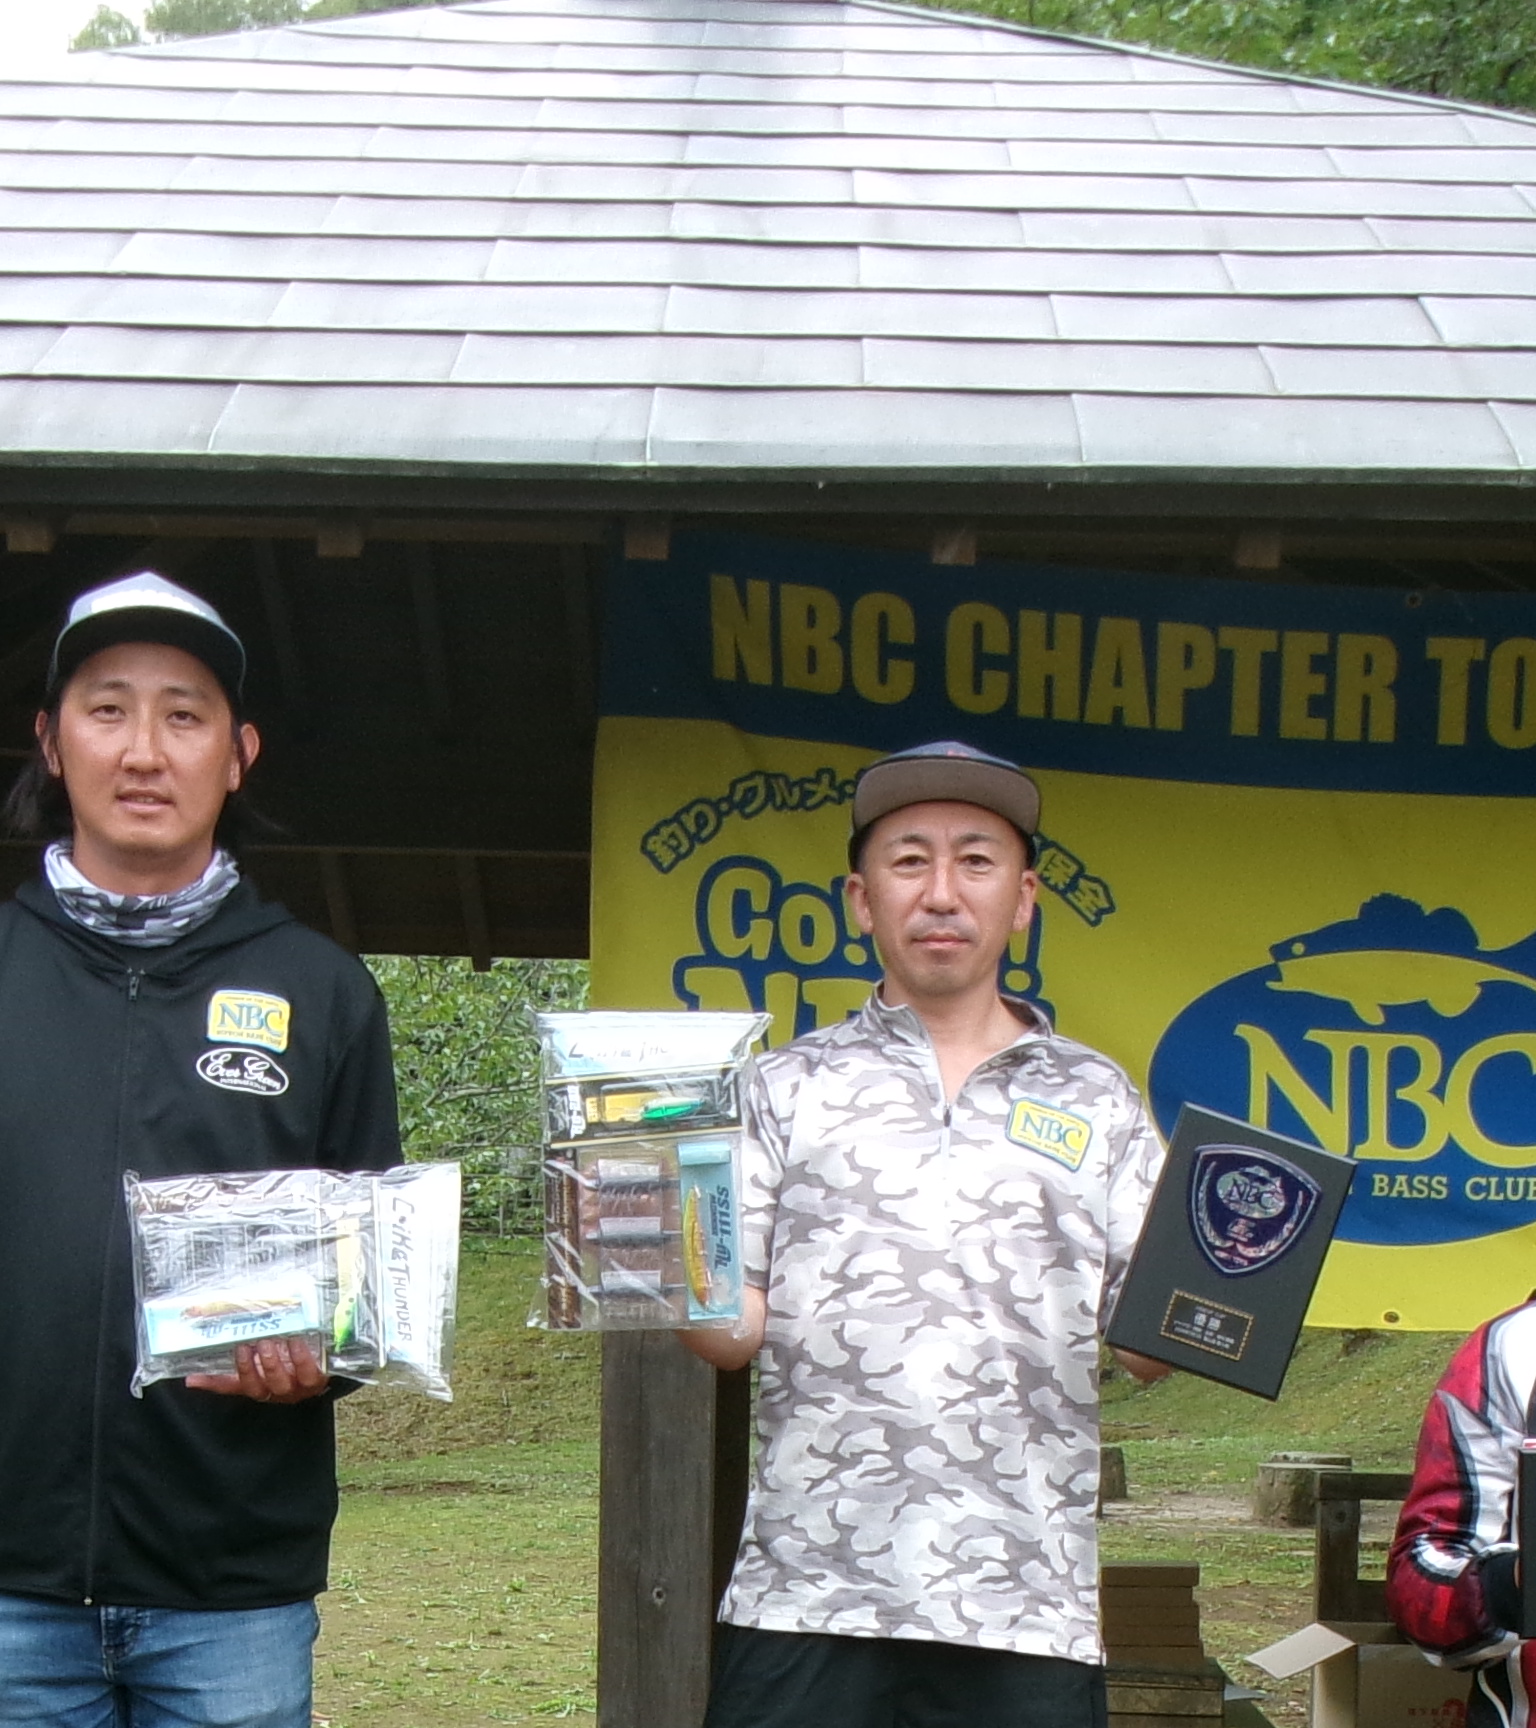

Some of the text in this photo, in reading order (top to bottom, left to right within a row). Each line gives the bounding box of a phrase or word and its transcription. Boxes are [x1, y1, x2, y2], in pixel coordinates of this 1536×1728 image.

[710, 575, 916, 705] NBC
[946, 602, 1399, 744] CHAPTER
[217, 1002, 283, 1037] NBC
[1020, 1111, 1082, 1154] NBC
[1372, 1174, 1448, 1199] BASS
